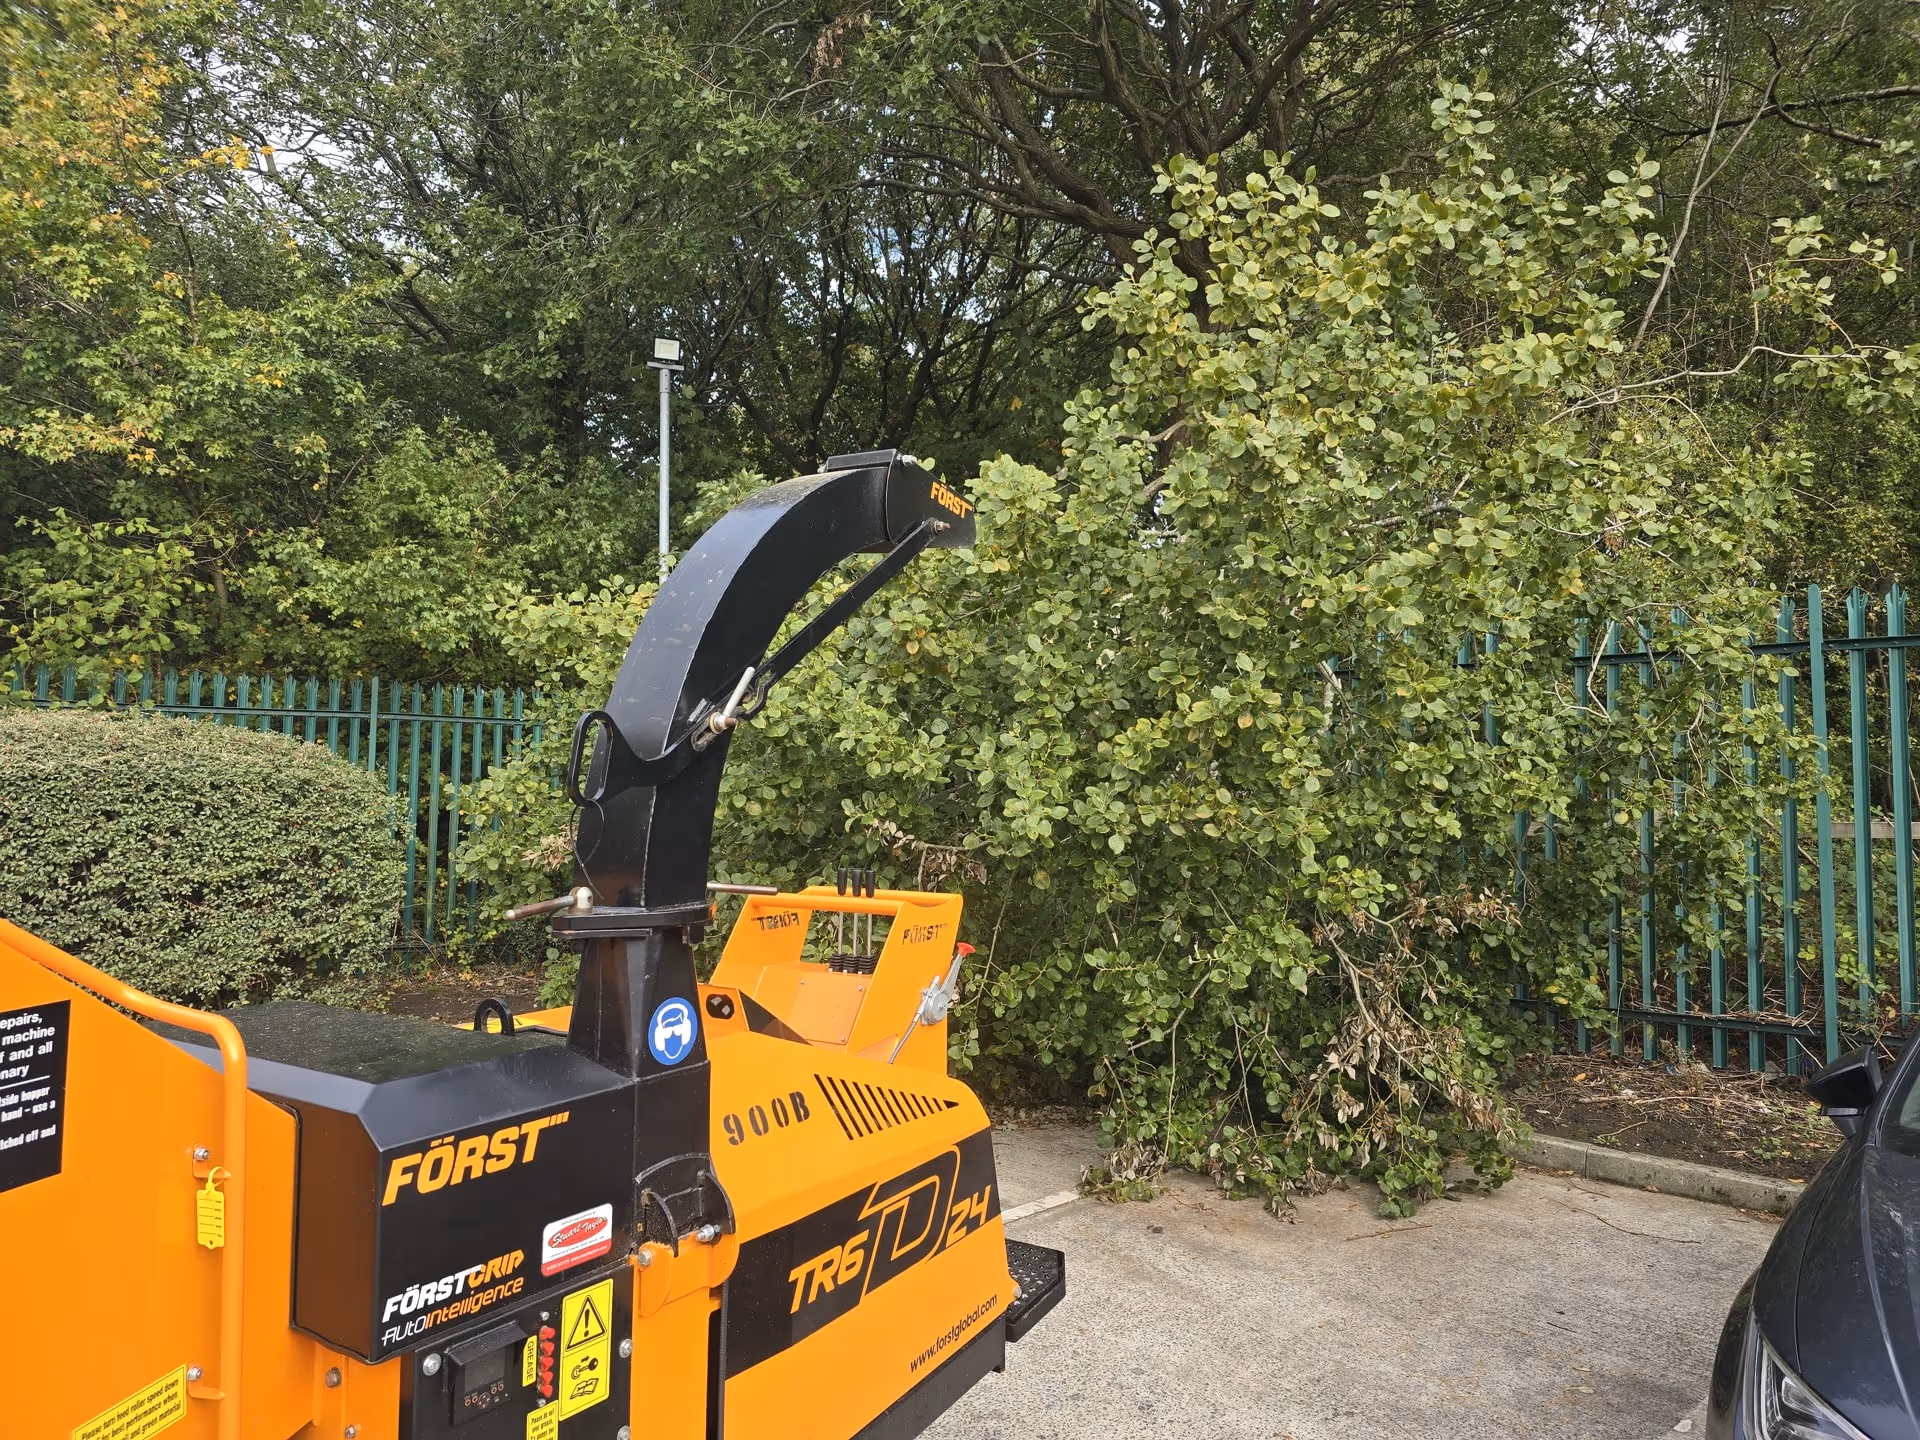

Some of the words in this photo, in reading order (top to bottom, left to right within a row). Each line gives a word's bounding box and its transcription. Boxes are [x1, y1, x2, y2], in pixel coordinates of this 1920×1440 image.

[930, 481, 972, 519] FÖRST
[0, 1013, 43, 1030] epairs,
[2, 1026, 56, 1046] machine
[9, 1045, 34, 1061] and
[38, 1041, 53, 1055] all
[1, 1107, 23, 1122] hand
[32, 1102, 48, 1114] use
[50, 1100, 56, 1109] a
[21, 1087, 50, 1102] hopper
[25, 1129, 39, 1143] off
[40, 1124, 56, 1138] and
[723, 1091, 810, 1146] 900B
[382, 1111, 569, 1207] FÖRST
[910, 1294, 998, 1373] www.forstglobal.com
[526, 1341, 535, 1382] GREASE
[103, 1417, 116, 1430] turn
[117, 1405, 130, 1421] feed
[131, 1399, 146, 1413] roller
[147, 1385, 163, 1404] speed
[164, 1378, 178, 1393] down
[112, 1423, 124, 1438] best
[126, 1401, 162, 1431] performance
[163, 1391, 178, 1405] when
[142, 1417, 158, 1435] green
[159, 1400, 181, 1421] material
